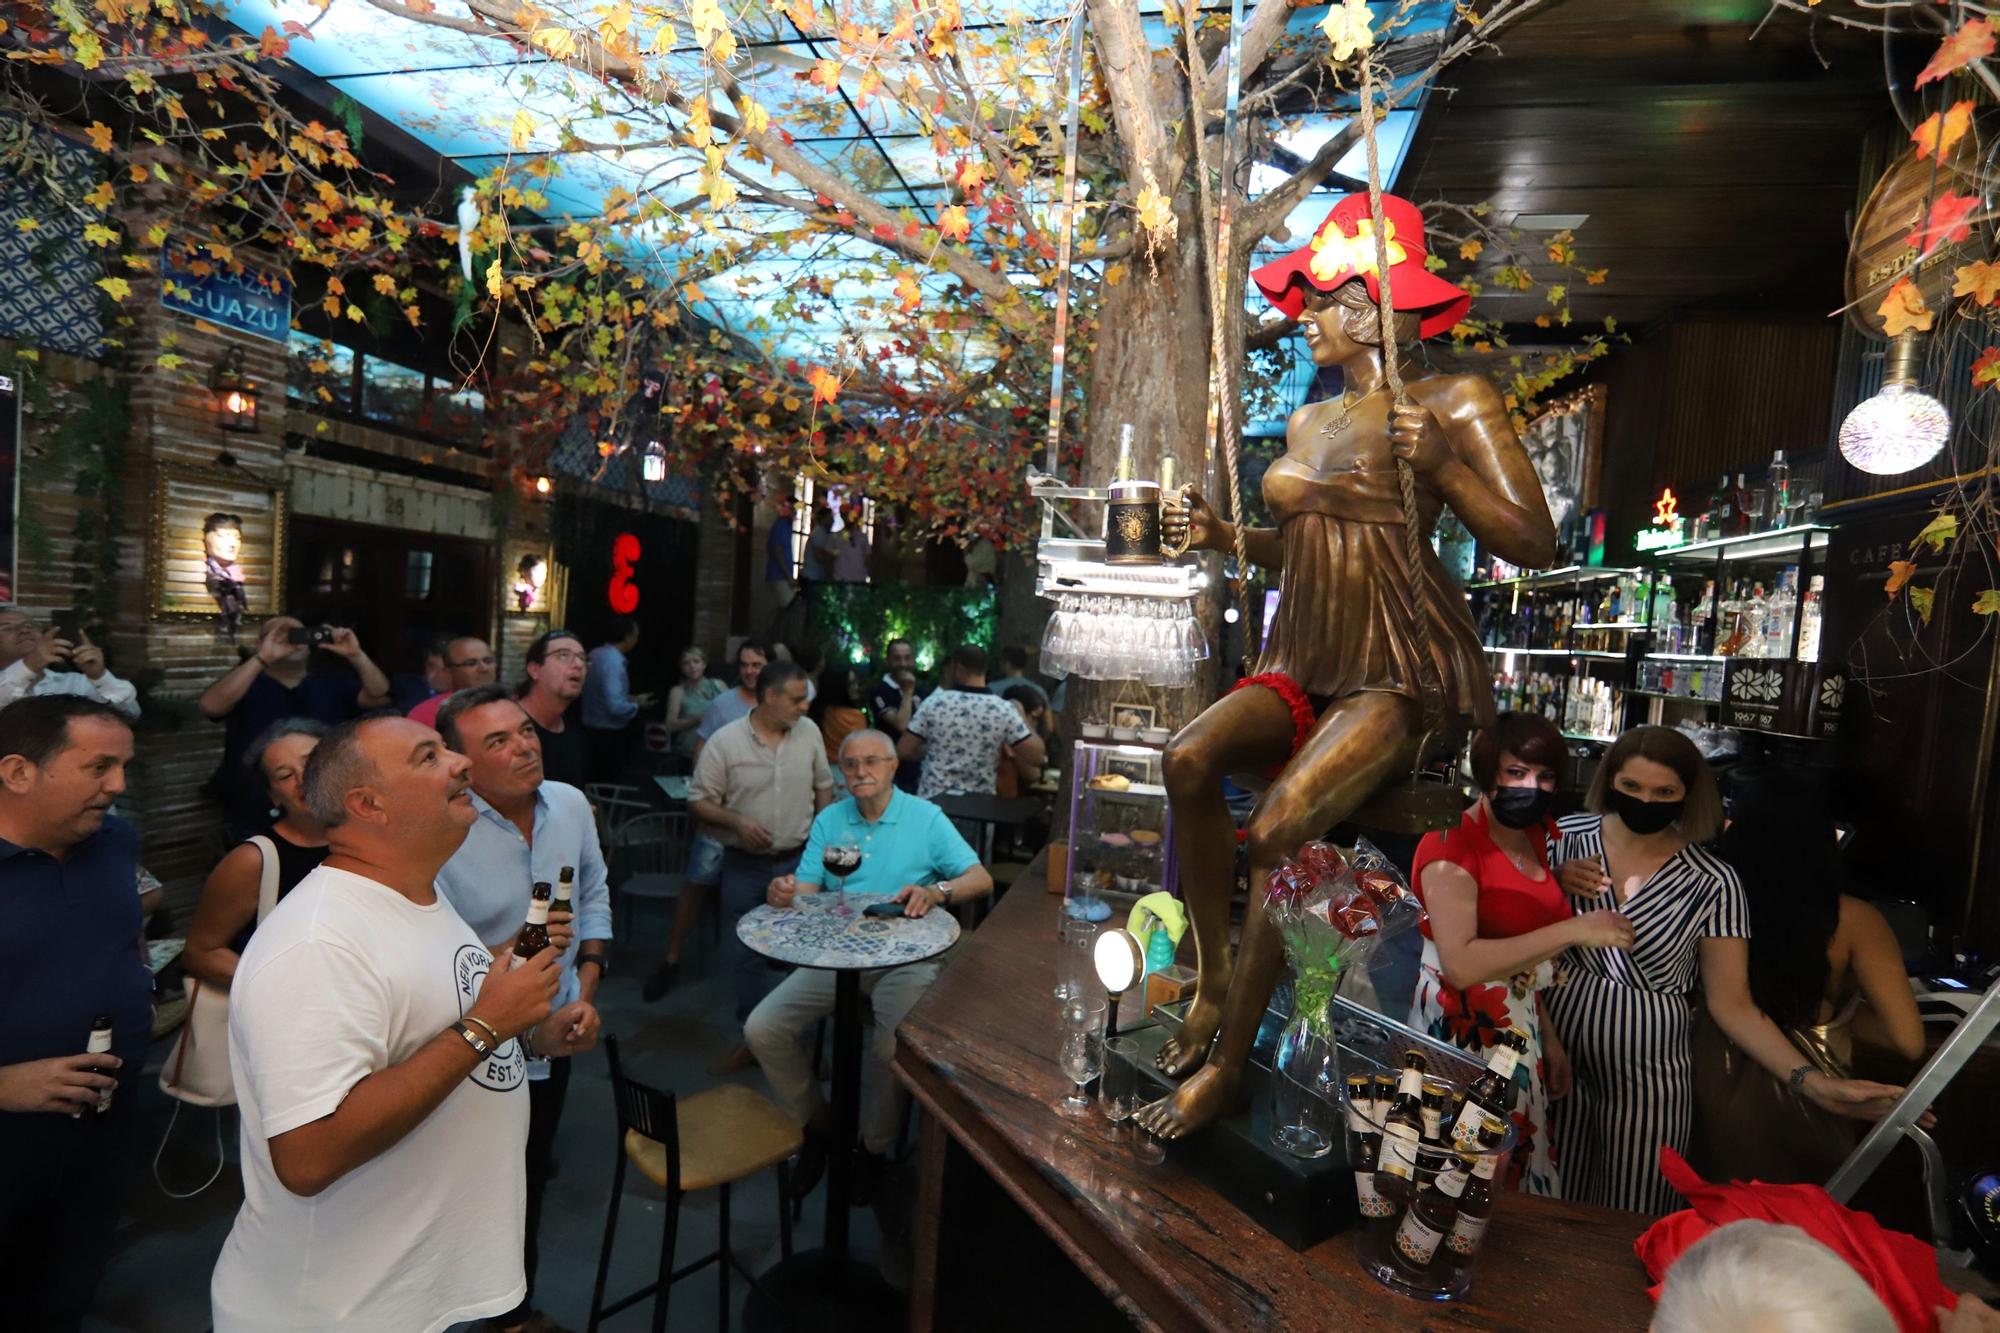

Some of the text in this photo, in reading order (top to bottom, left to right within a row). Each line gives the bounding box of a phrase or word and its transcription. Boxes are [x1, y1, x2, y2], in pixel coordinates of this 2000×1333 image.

[209, 264, 273, 299] LAZA
[1733, 711, 1756, 722] 1967
[459, 958, 472, 996] NEW
[486, 1062, 516, 1083] EST.
